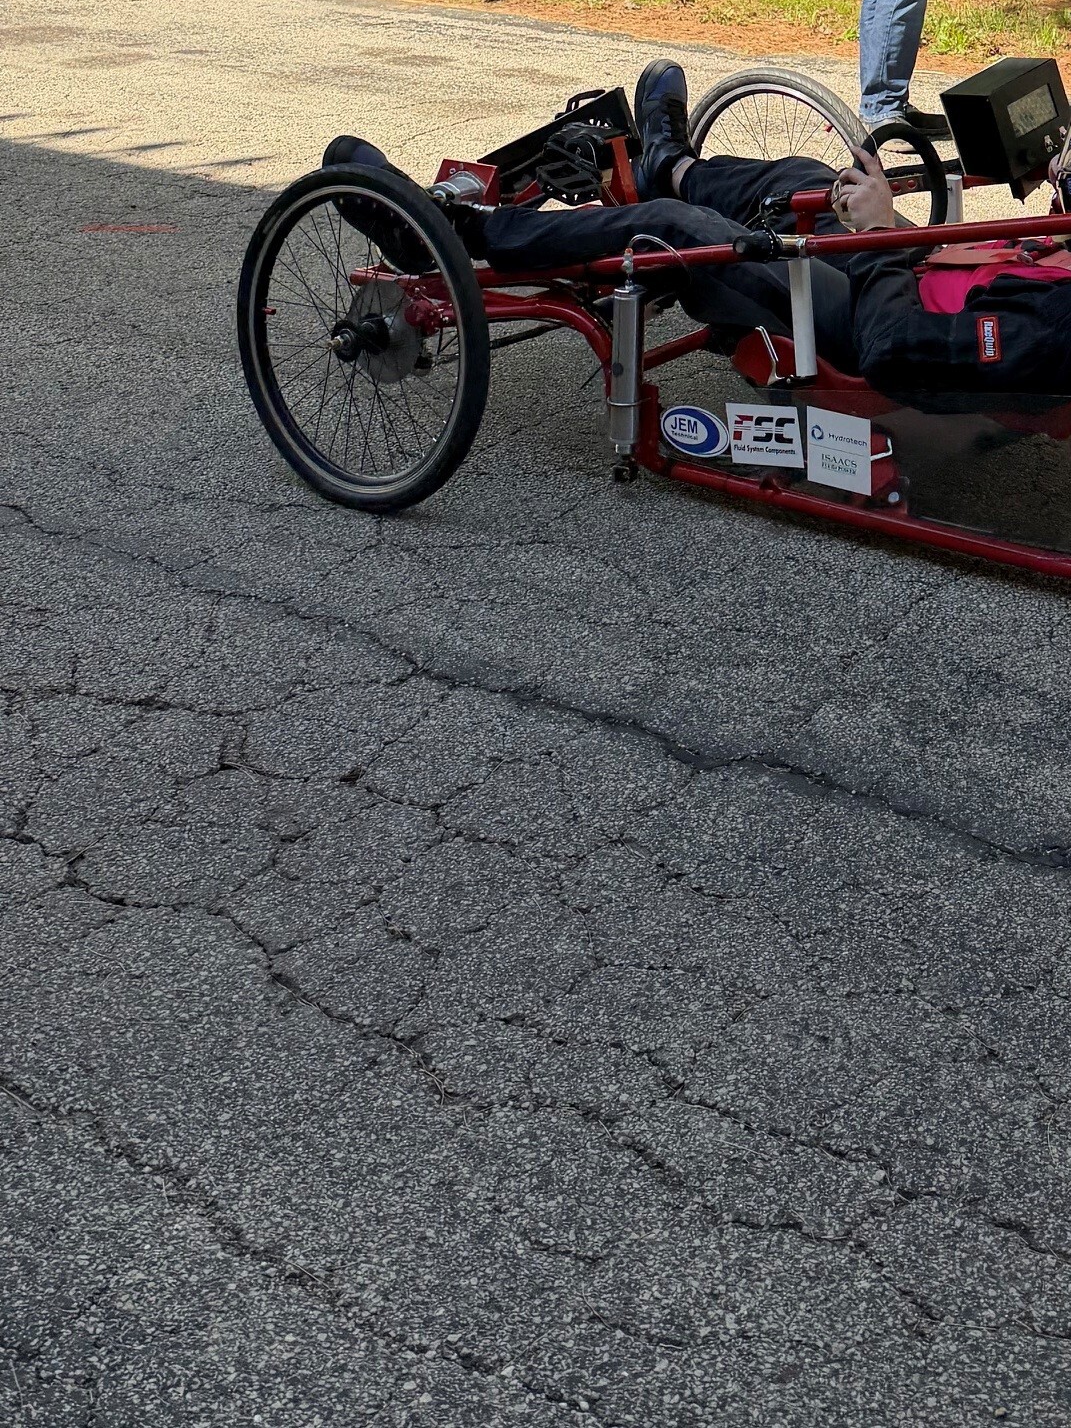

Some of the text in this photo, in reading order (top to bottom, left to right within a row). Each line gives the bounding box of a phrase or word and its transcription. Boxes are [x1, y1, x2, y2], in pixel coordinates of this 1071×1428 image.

[670, 416, 698, 434] JEM
[733, 414, 796, 445] FSC
[671, 430, 699, 441] Technical
[828, 432, 868, 447] Hydrotech
[733, 444, 796, 456] Fluid System Components
[821, 453, 858, 469] ISAACS
